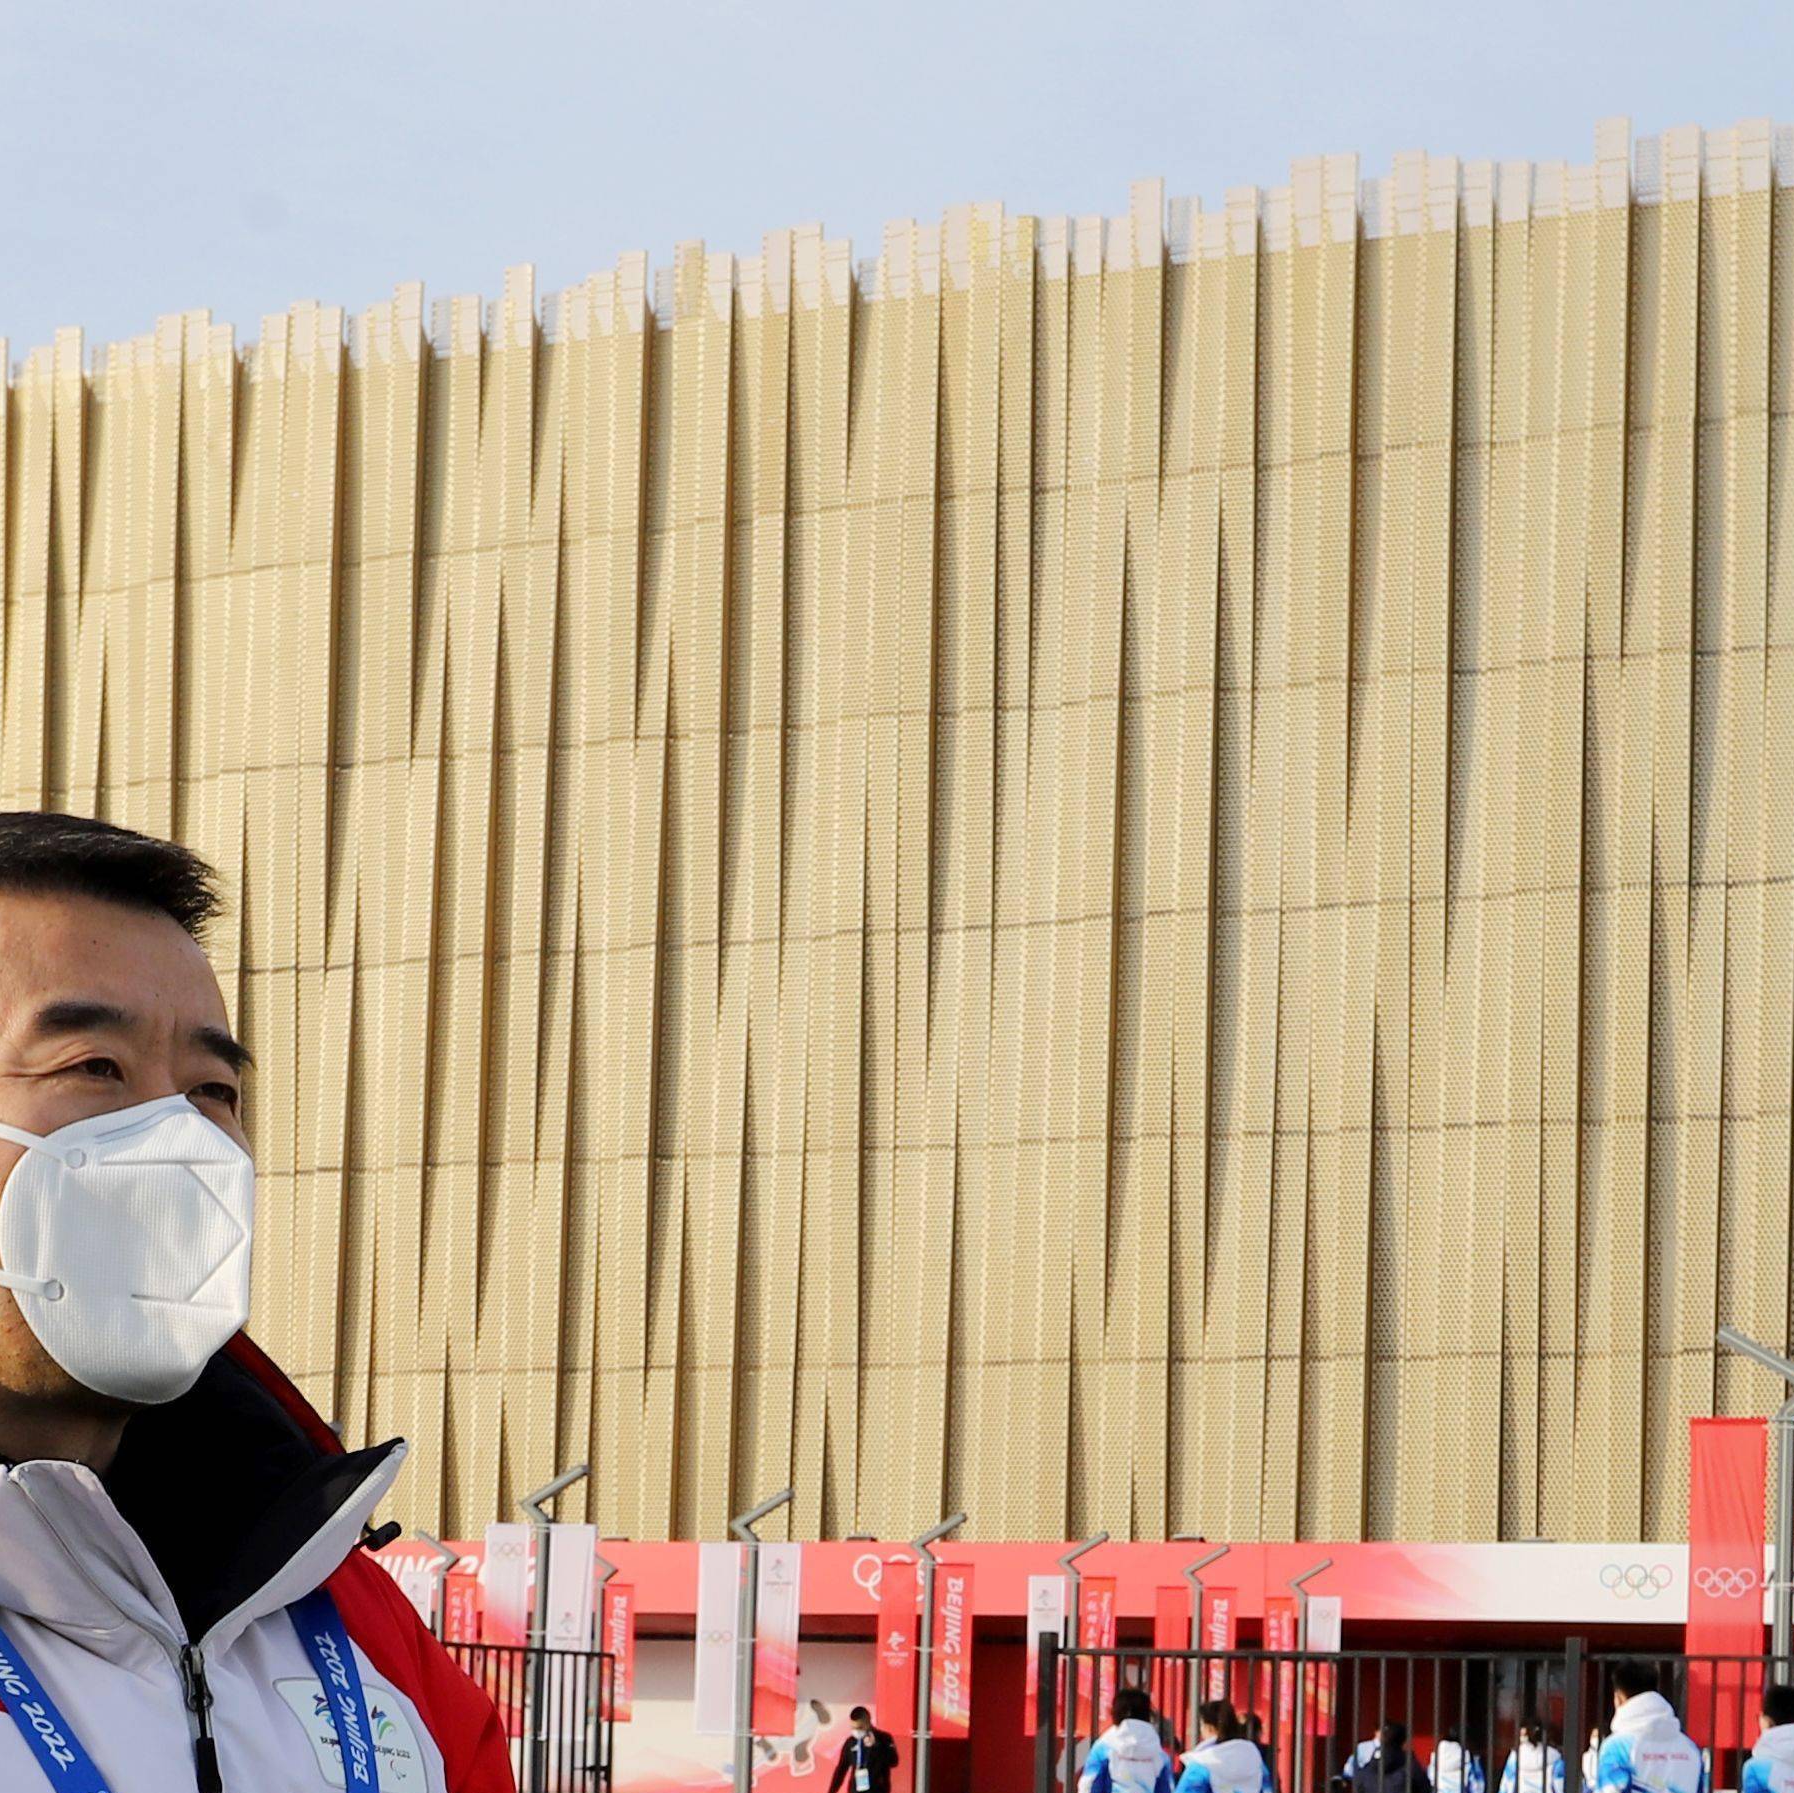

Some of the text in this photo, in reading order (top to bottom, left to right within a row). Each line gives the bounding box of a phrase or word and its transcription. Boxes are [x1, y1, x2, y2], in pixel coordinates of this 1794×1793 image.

[939, 1577, 964, 1655] BEIJING
[20, 1701, 76, 1772] 2022
[314, 1632, 370, 1785] BEIJING 2022
